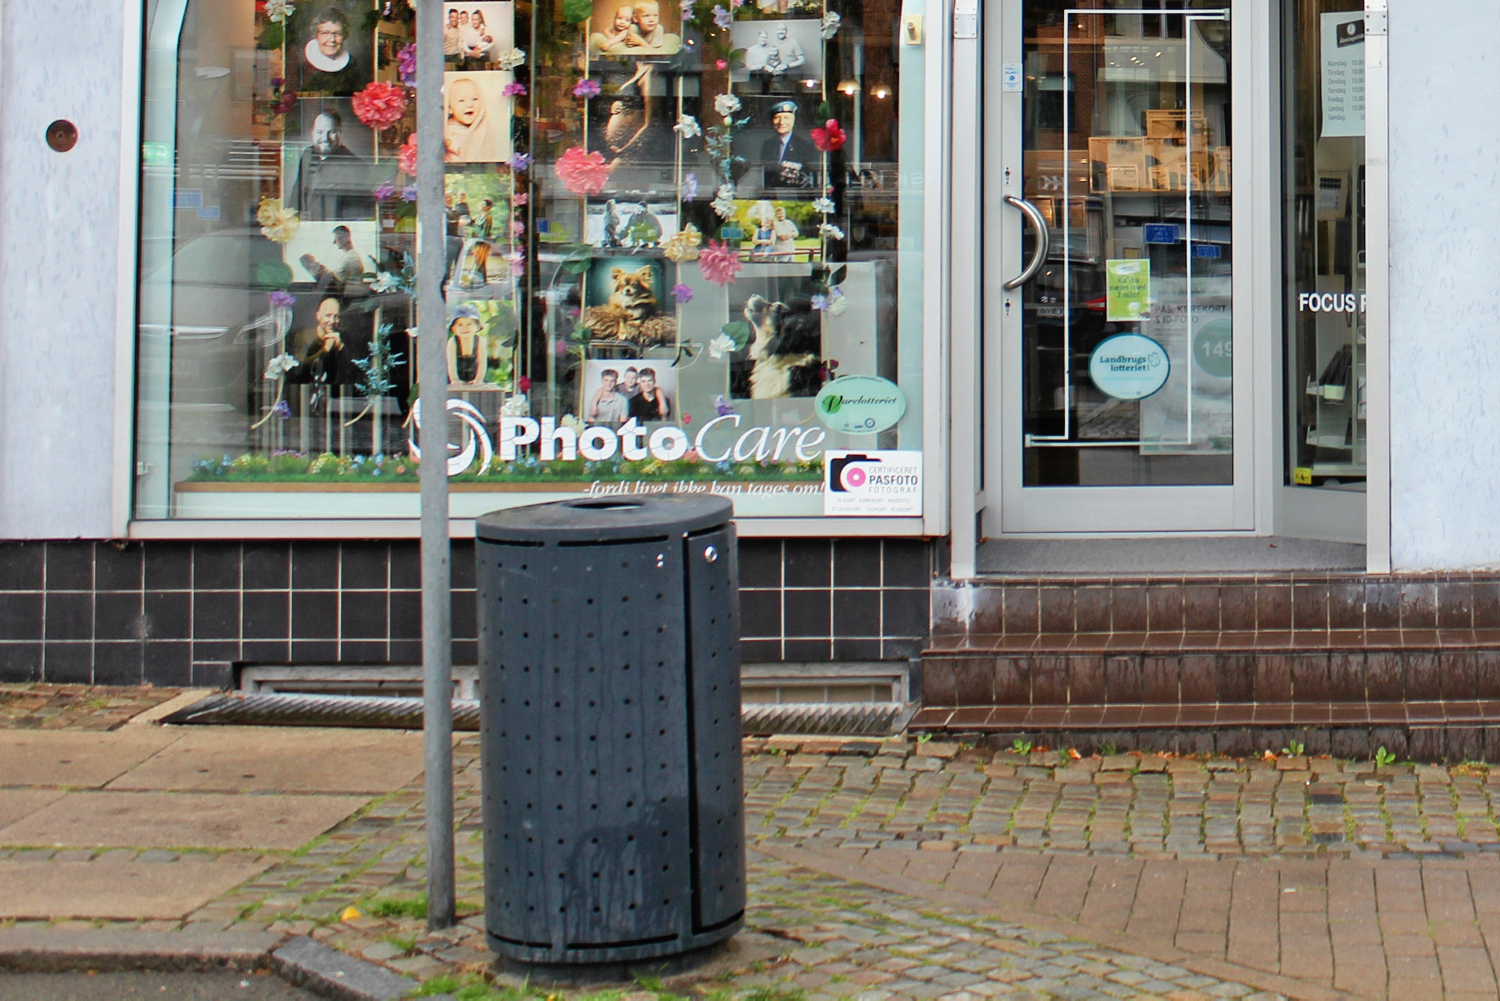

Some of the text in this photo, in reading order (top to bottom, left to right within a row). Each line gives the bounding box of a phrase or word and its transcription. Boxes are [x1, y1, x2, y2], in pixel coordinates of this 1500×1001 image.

[1299, 292, 1356, 313] FOCUS
[1163, 315, 1199, 323] ID-FOO
[1100, 355, 1147, 364] Landbrugs
[499, 414, 826, 463] Photo Care
[869, 466, 918, 474] CERTIFICERET
[868, 475, 918, 485] PASFOTO
[710, 480, 742, 496] kan
[747, 482, 790, 499] tages
[868, 486, 917, 494] FOTOGRAF
